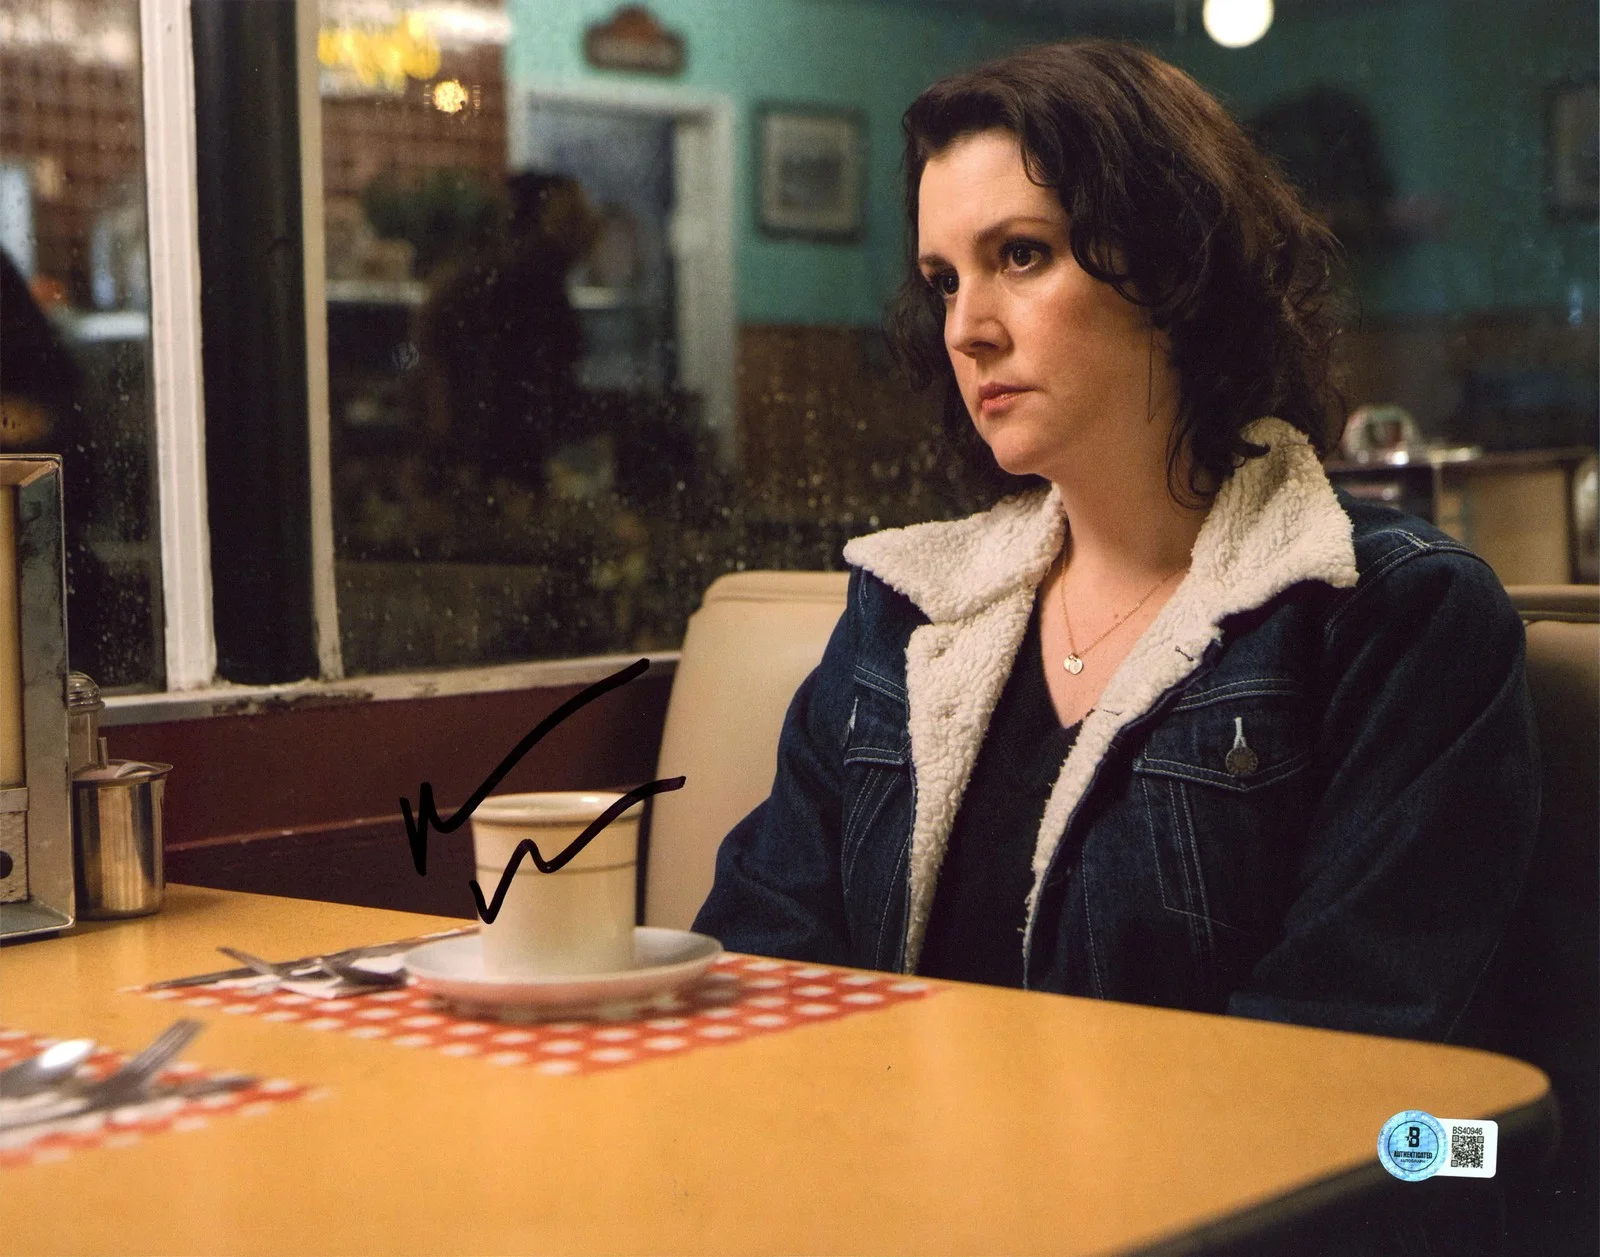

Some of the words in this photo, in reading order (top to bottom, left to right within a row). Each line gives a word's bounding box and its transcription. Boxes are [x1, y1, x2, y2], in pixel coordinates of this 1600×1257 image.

[1452, 1126, 1483, 1135] BS40946
[1408, 1127, 1420, 1148] B
[1394, 1151, 1433, 1159] AUTHENTICATED
